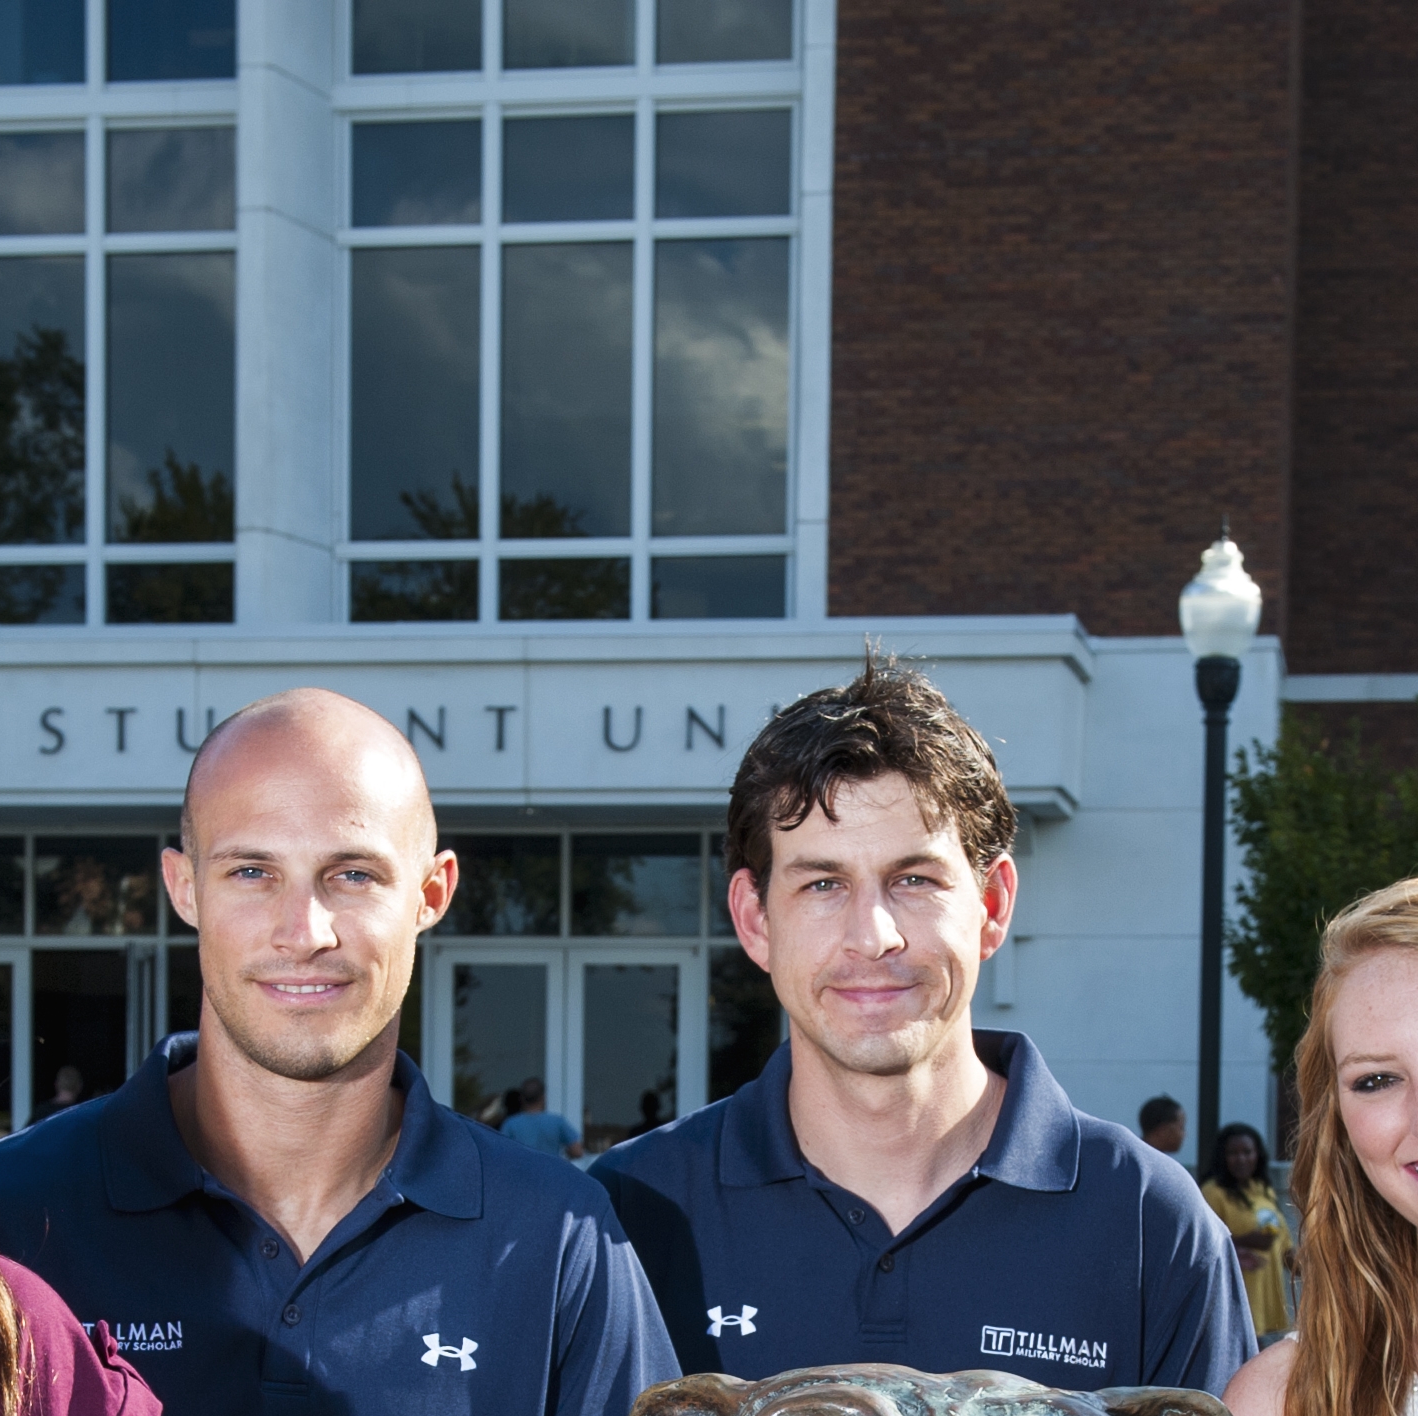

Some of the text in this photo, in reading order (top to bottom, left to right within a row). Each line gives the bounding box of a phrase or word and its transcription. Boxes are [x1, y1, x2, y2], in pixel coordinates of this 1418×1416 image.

[38, 704, 519, 756] STUNT
[83, 1321, 183, 1341] TLMAN
[133, 1340, 183, 1351] SCHOLAR
[1016, 1331, 1108, 1359] TILLMAN
[1015, 1346, 1107, 1368] MILITARY SCHOLAR
